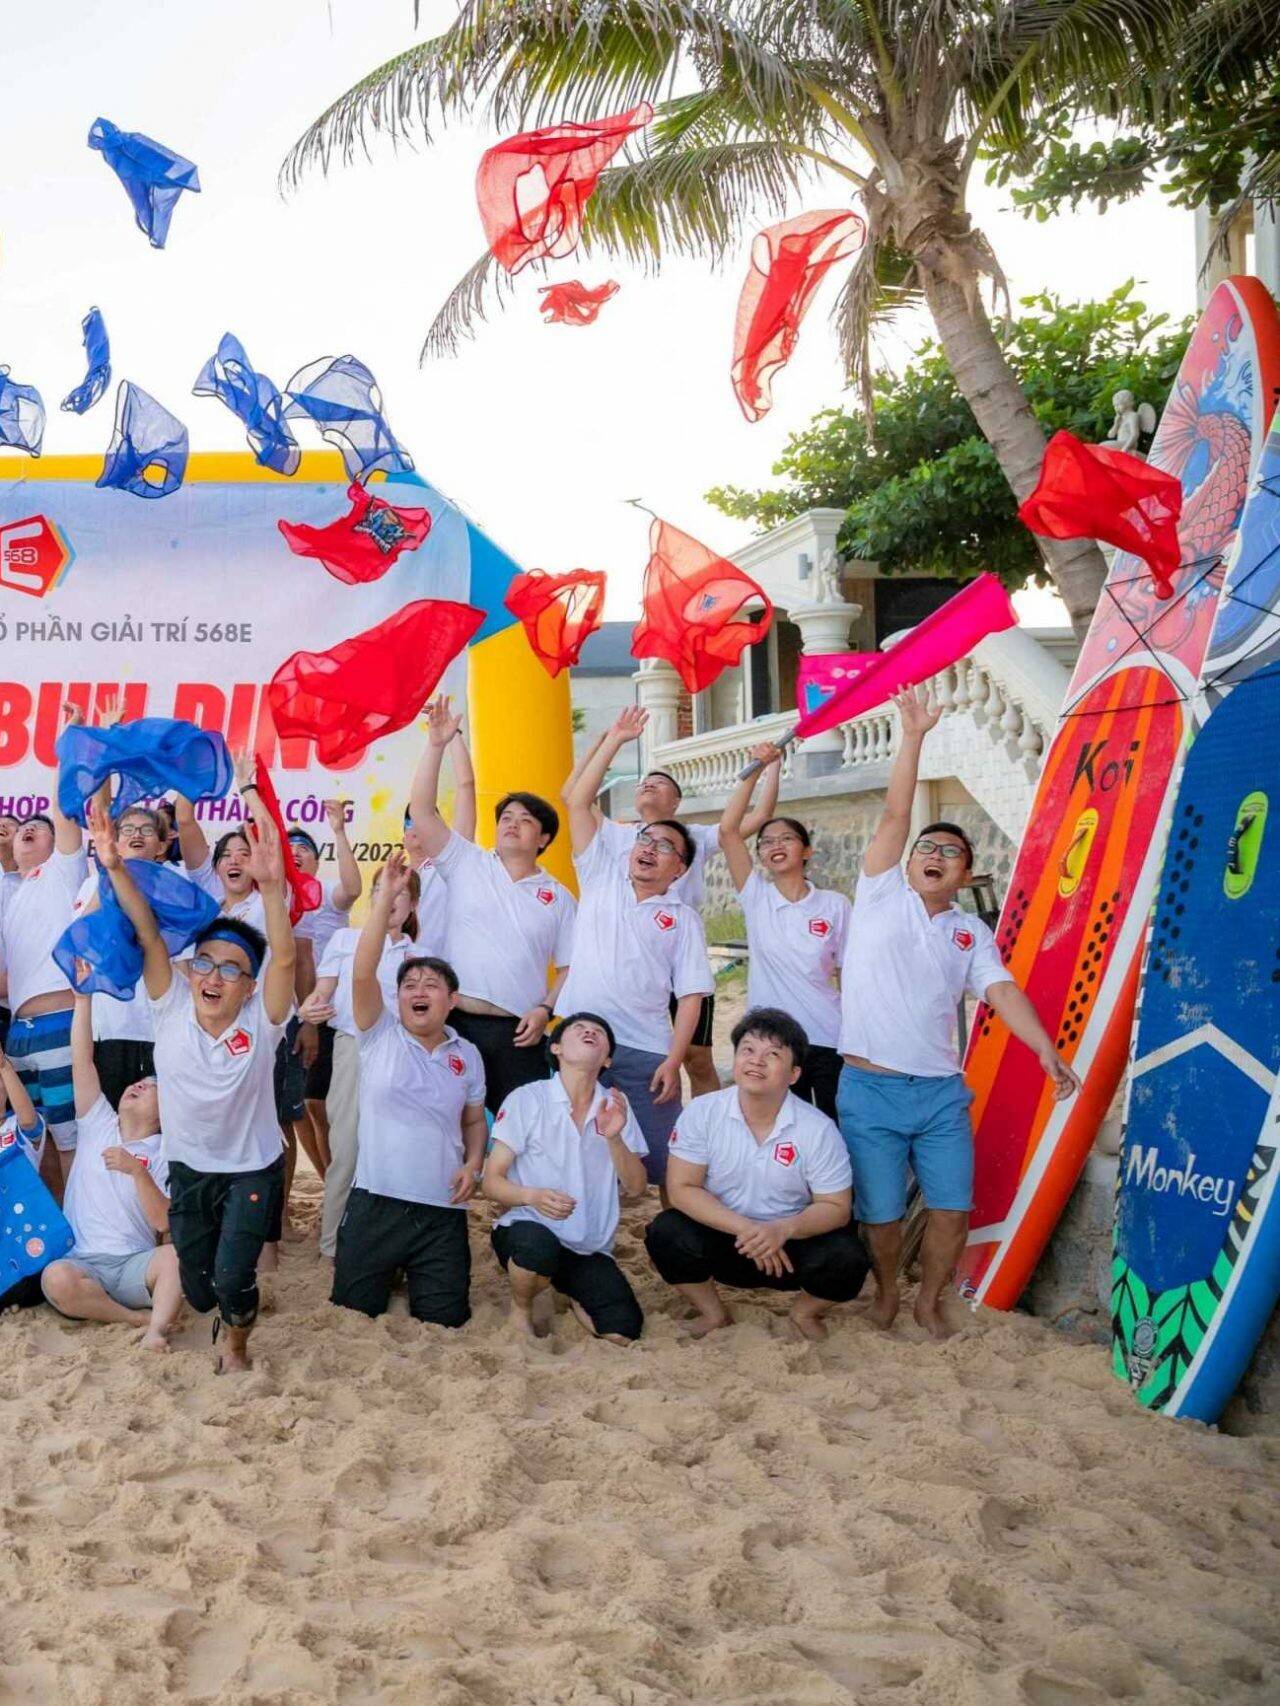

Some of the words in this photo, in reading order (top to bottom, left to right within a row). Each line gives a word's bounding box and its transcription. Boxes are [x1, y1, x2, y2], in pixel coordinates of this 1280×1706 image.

[4, 548, 37, 564] 568
[16, 613, 82, 642] PHẦN
[90, 613, 143, 642] GIẢI
[150, 616, 189, 642] TRÍ
[194, 623, 252, 643] 568E
[1070, 739, 1141, 795] Koi
[1125, 1143, 1235, 1217] Monkey
